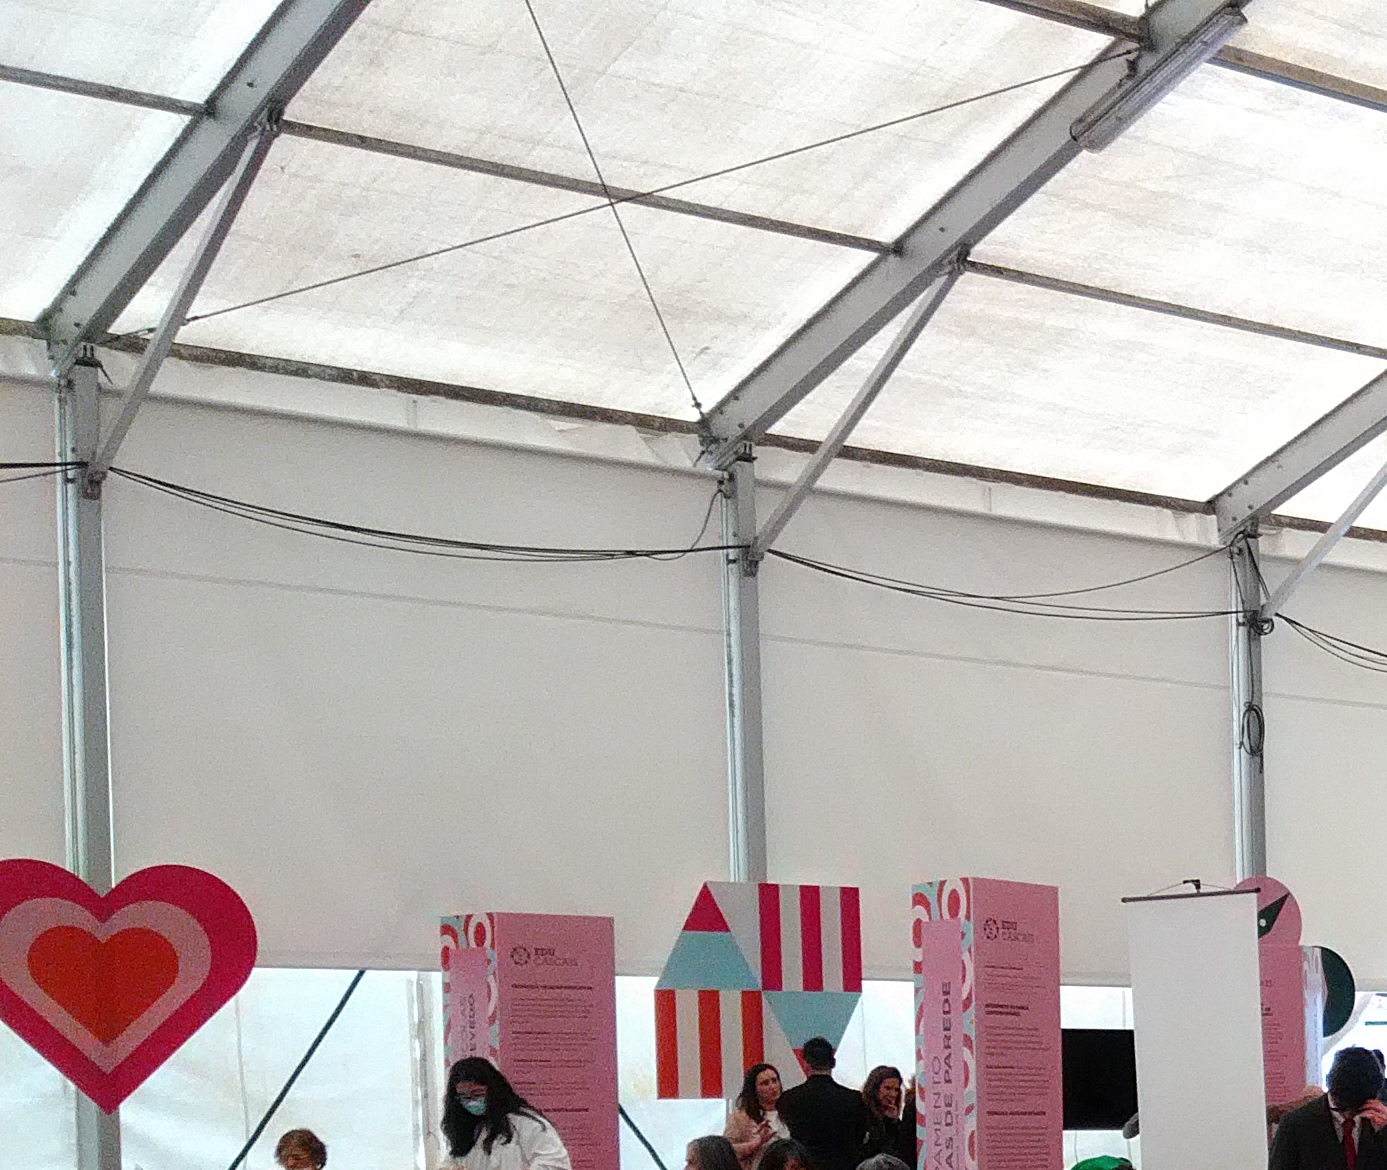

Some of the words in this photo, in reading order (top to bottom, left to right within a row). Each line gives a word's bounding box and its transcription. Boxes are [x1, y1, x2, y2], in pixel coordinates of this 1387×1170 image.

[533, 947, 556, 957] EDU
[941, 980, 953, 1084] PAREDE
[943, 1092, 954, 1127] DE
